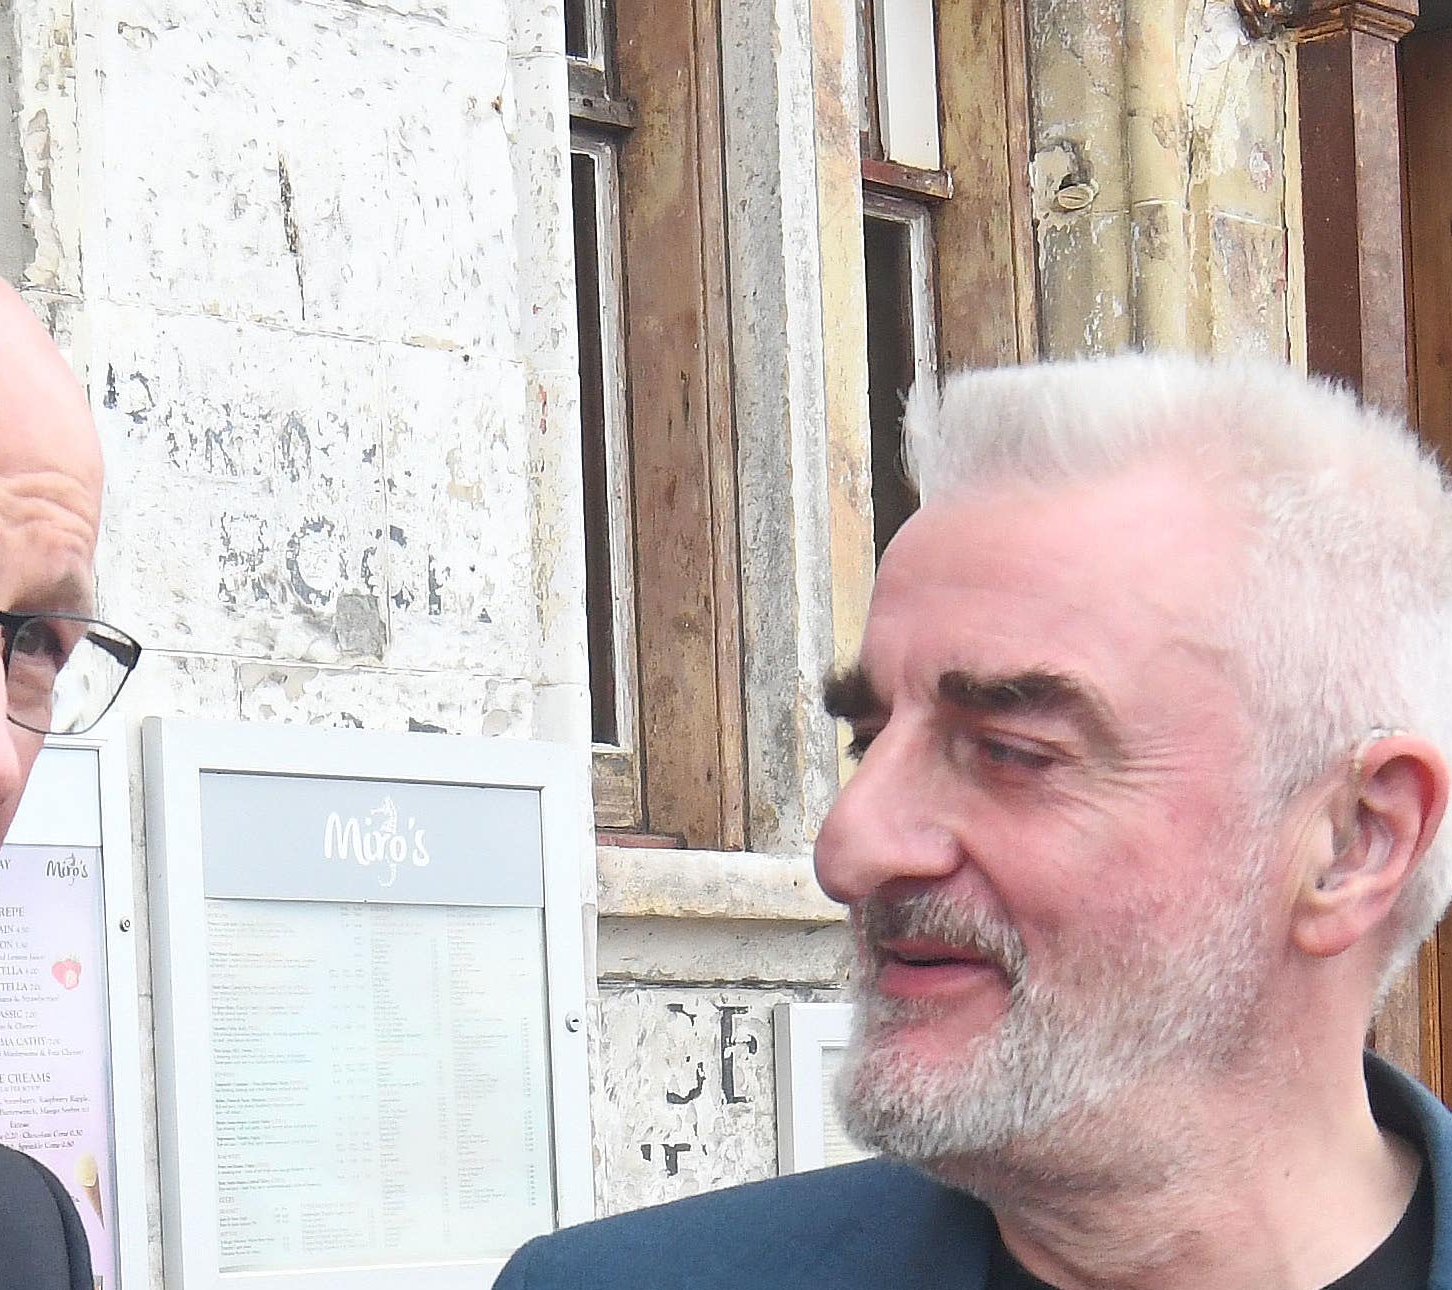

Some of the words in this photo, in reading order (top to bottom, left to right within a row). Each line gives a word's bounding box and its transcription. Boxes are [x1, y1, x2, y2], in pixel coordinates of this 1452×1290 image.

[323, 811, 430, 867] Miro's
[46, 858, 89, 879] Miro's
[16, 1036, 46, 1046] CATHY
[7, 1072, 51, 1085] CREAMS
